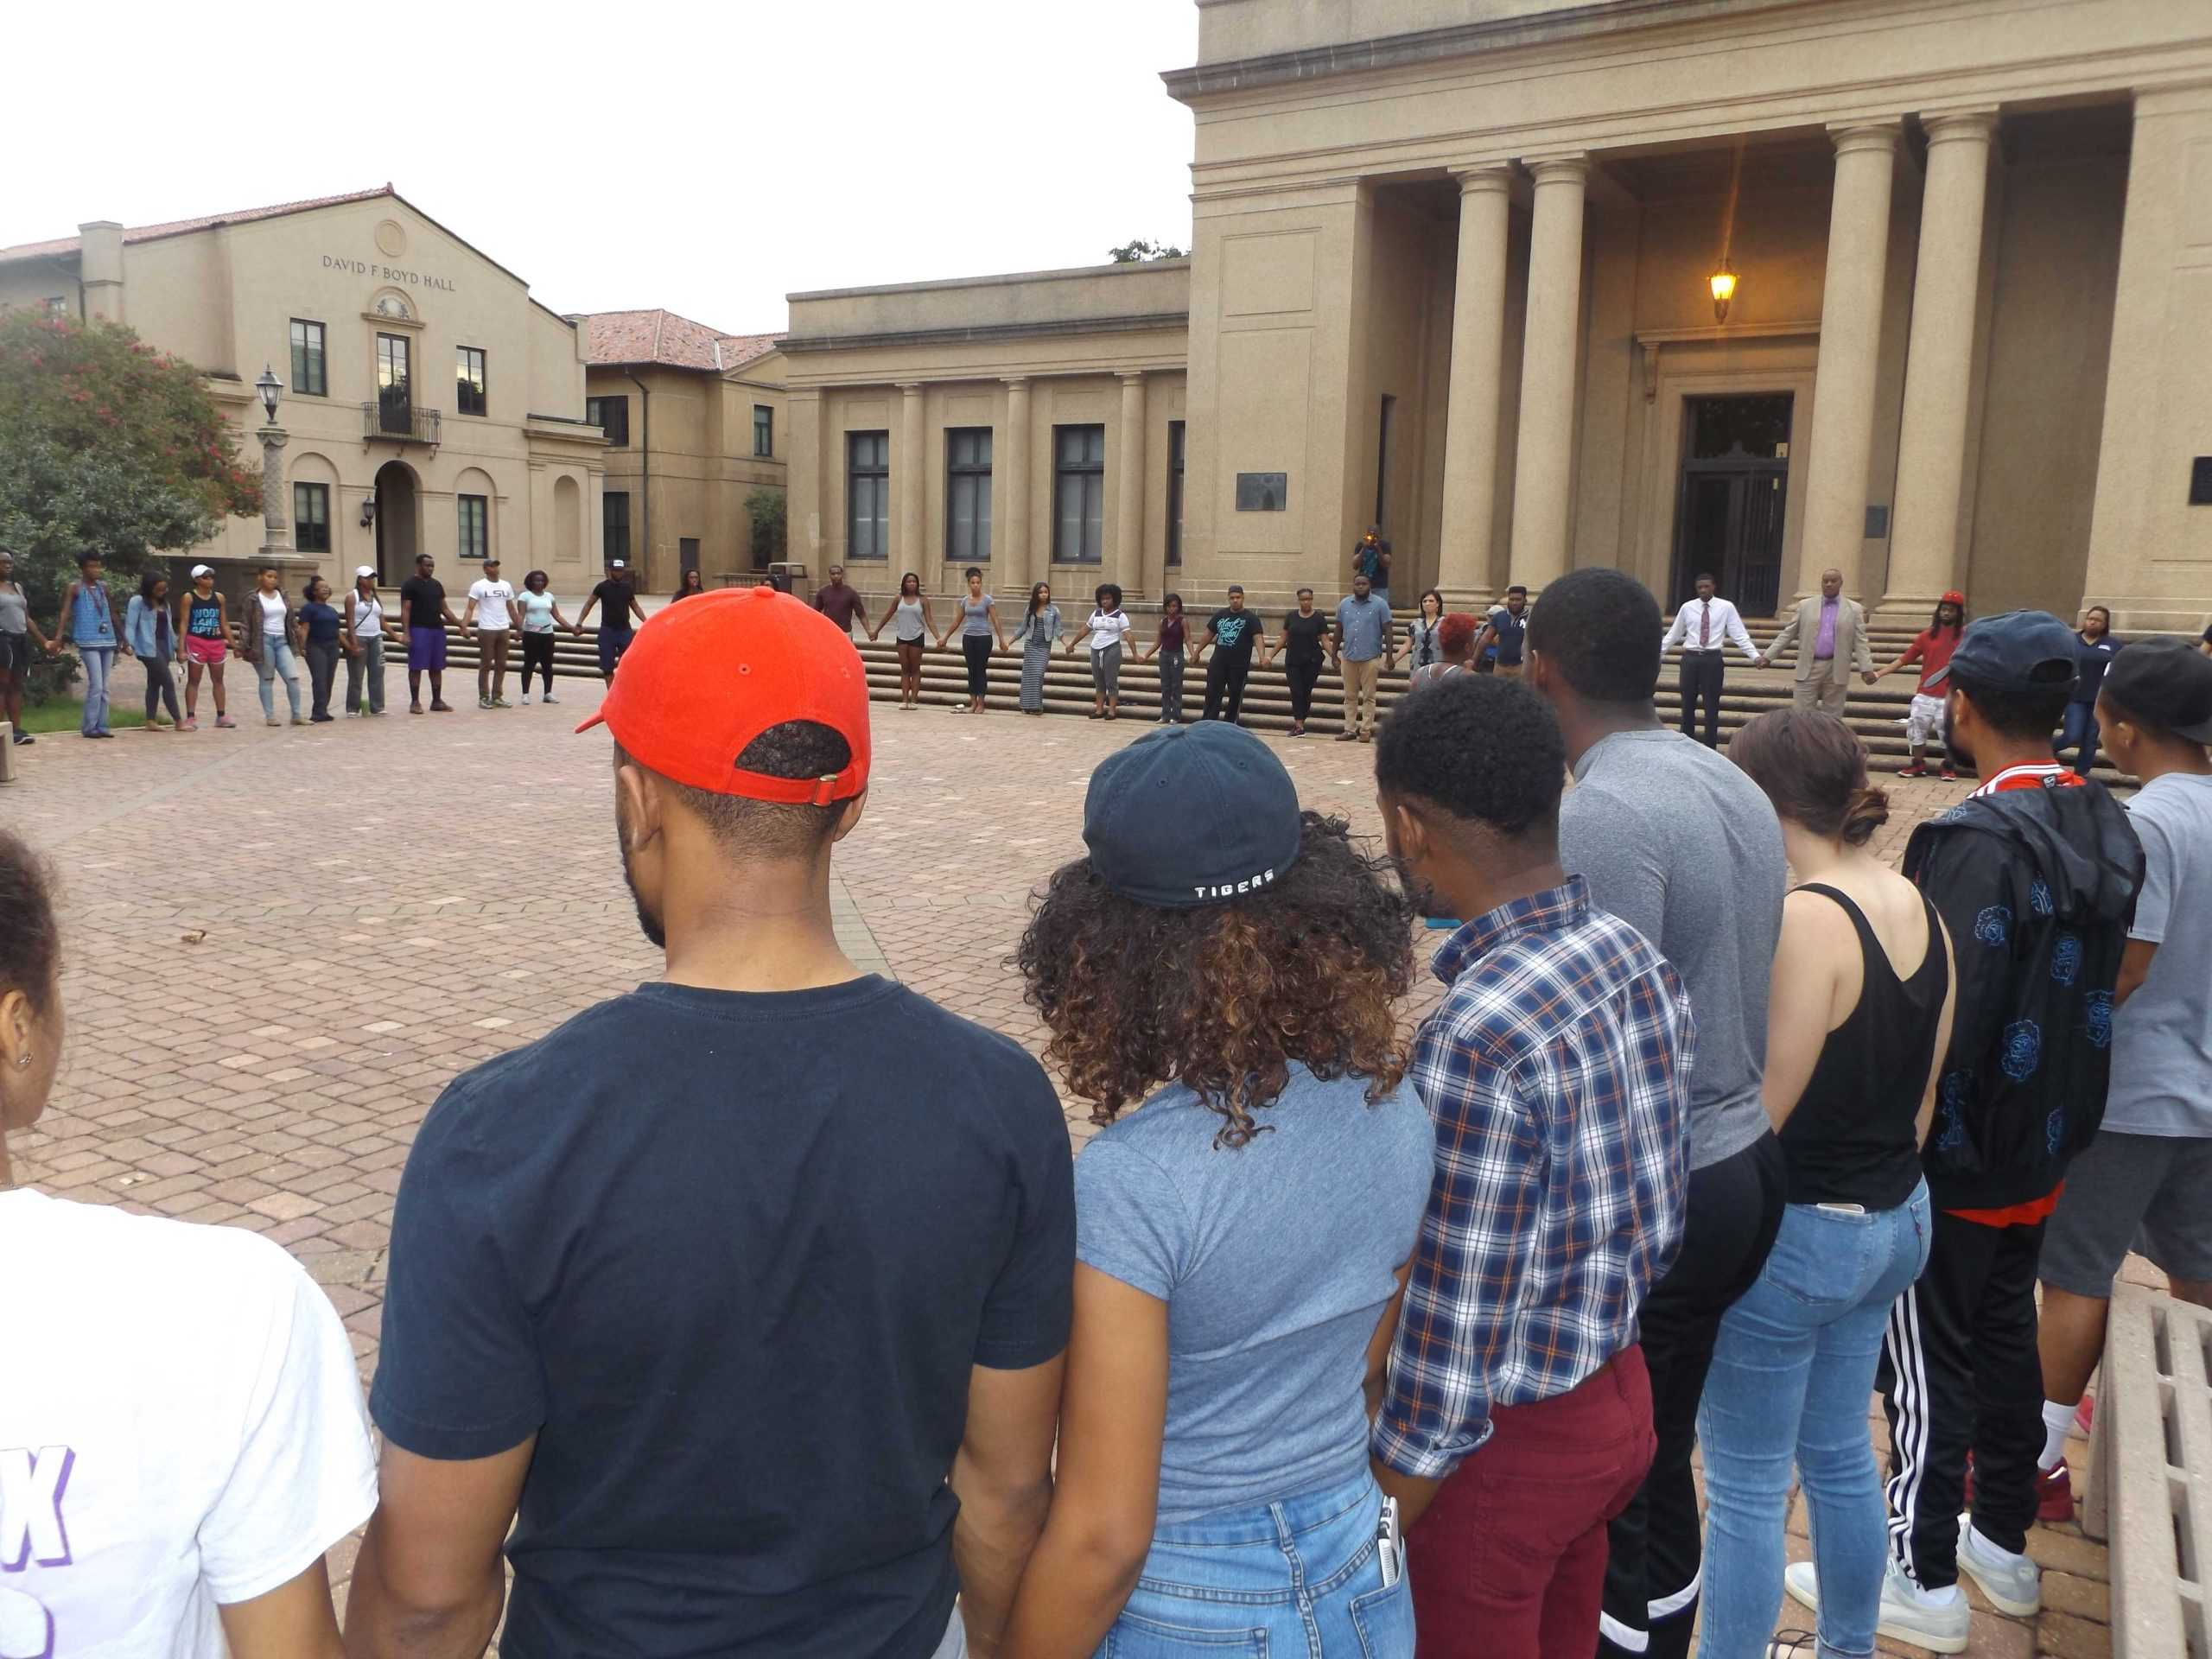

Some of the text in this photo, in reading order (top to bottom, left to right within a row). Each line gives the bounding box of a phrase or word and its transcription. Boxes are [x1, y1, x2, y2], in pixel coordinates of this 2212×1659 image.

[323, 255, 366, 274] DAVID
[384, 267, 419, 284] BOYD
[424, 276, 456, 292] HALL
[1194, 868, 1274, 899] TIGERS
